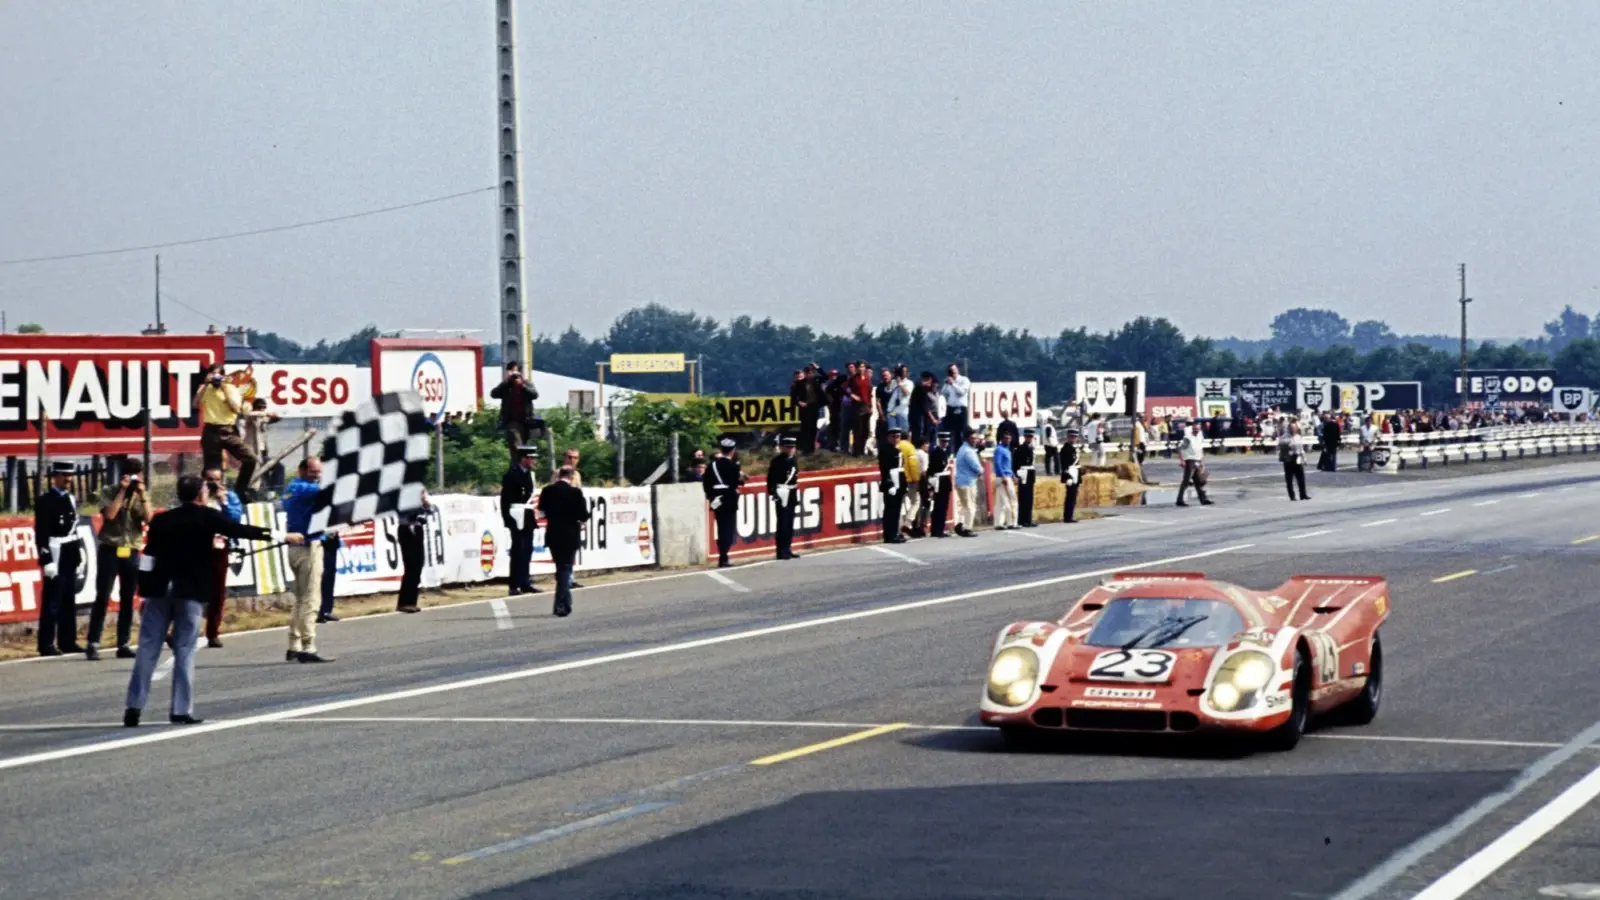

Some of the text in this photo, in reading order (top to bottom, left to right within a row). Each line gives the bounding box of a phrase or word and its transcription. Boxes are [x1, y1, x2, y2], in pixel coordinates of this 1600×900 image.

[972, 390, 1034, 420] LUCAS
[1307, 393, 1322, 405] BP
[1563, 392, 1582, 405] BP
[1151, 405, 1193, 419] super
[1090, 651, 1173, 678] 23
